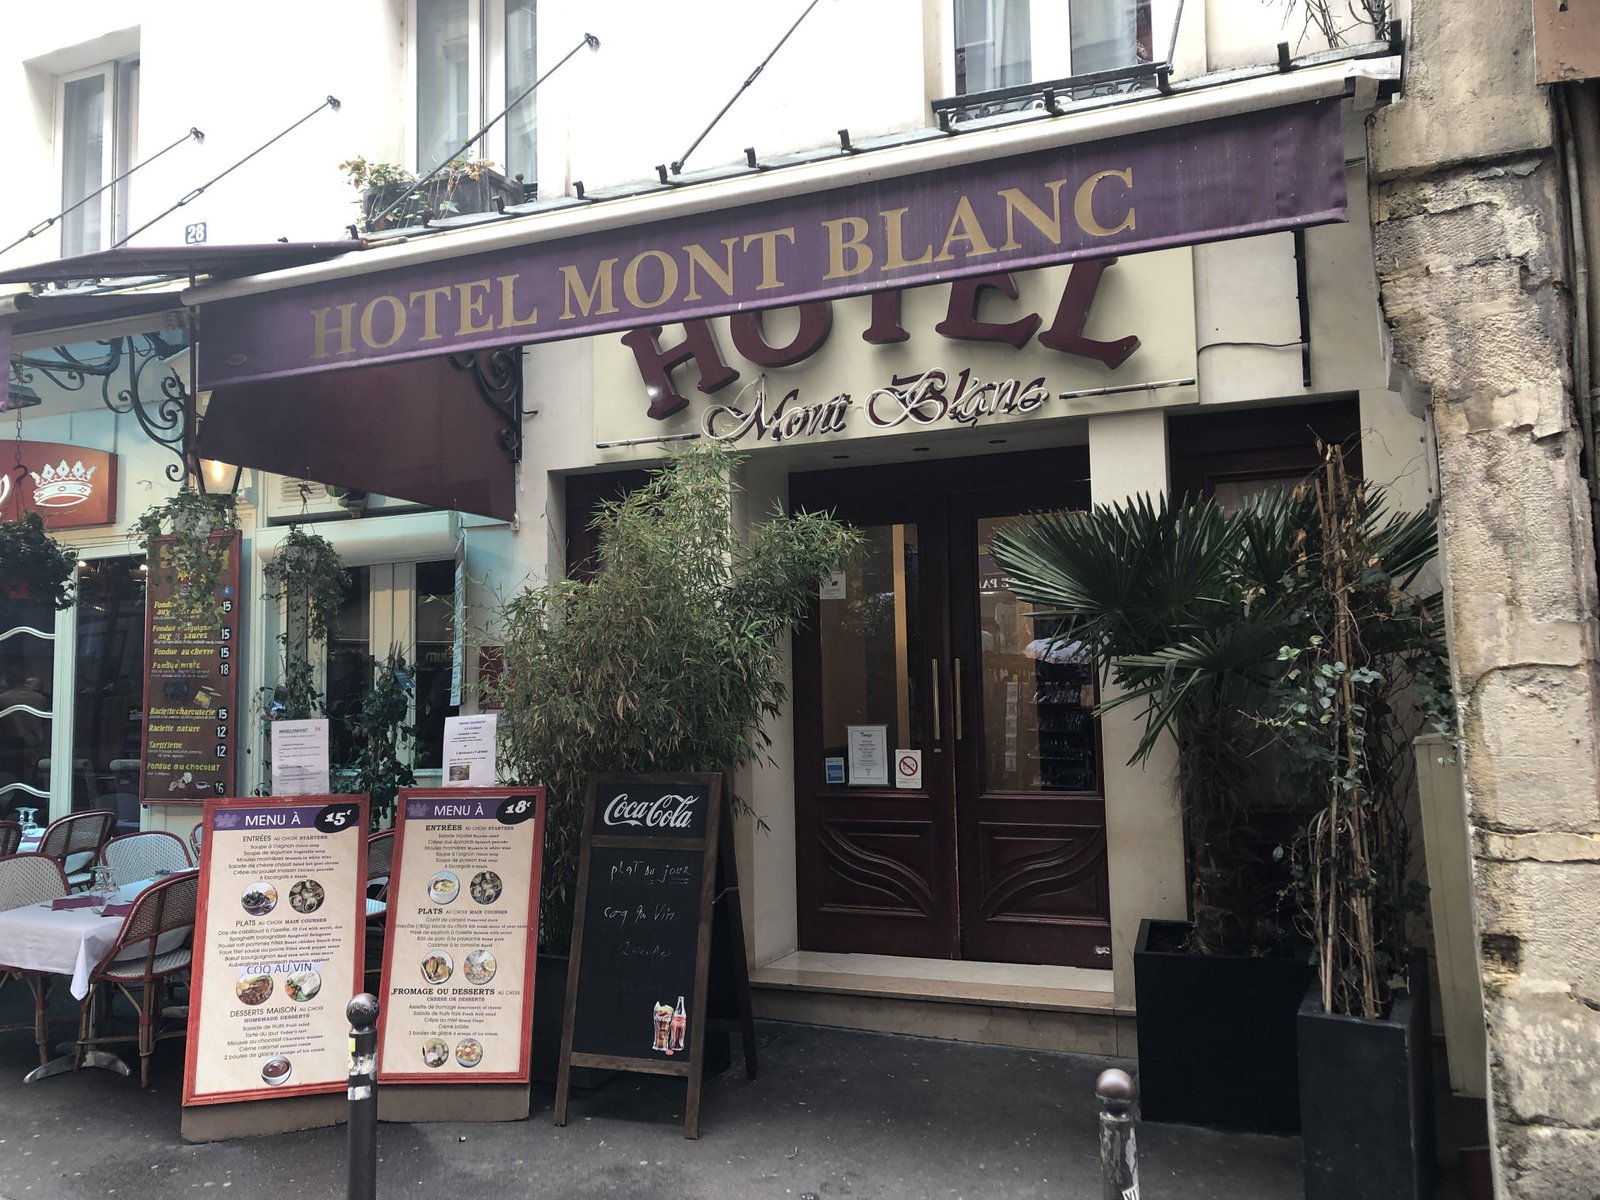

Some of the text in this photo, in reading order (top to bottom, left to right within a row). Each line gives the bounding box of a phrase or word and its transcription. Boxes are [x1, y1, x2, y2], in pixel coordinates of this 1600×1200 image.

[187, 223, 206, 243] 28
[311, 167, 1138, 359] HOTEL MONT BLANC
[701, 368, 1050, 442] Mont Blanc
[223, 601, 231, 612] 15
[221, 628, 230, 640] 15
[154, 648, 178, 656] Fondue
[220, 648, 230, 658] 15
[220, 664, 229, 675] 18
[218, 709, 228, 719] 15
[148, 724, 227, 738] Raclette nature 12
[217, 745, 227, 757] 12
[434, 805, 470, 816] MENU
[474, 802, 484, 816] À
[603, 793, 700, 828] Coca-Cola
[245, 814, 286, 826] MENU
[290, 812, 301, 826] À
[425, 823, 462, 831] ENTRÉES
[242, 834, 272, 842] ENTRÉES
[236, 919, 256, 927] PLATS
[274, 964, 290, 974] AU
[293, 962, 312, 972] VIN
[392, 988, 434, 996] FROMAGE
[230, 1008, 264, 1018] DESSERTS
[266, 1006, 297, 1016] MAISON
